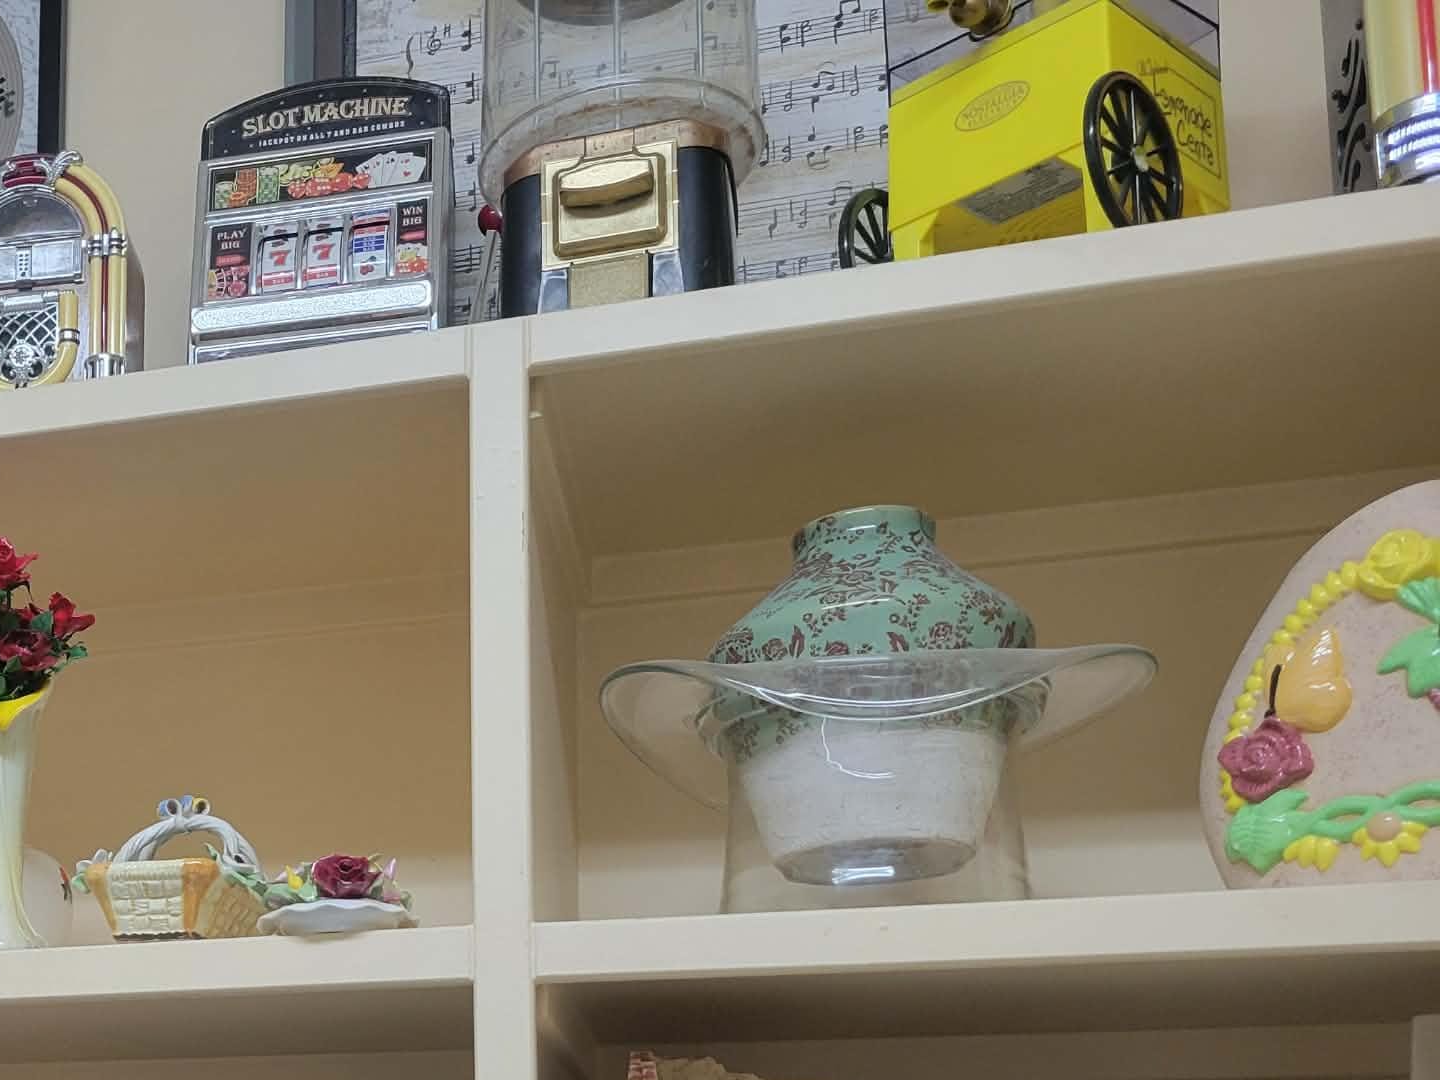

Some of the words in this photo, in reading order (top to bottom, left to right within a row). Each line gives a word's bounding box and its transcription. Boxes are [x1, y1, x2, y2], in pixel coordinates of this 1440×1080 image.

[242, 108, 300, 138] SLOT
[301, 97, 410, 125] MACHINE
[402, 206, 424, 217] WIN
[401, 216, 424, 227] BIG
[216, 227, 247, 241] PLAY
[220, 240, 241, 250] BIG
